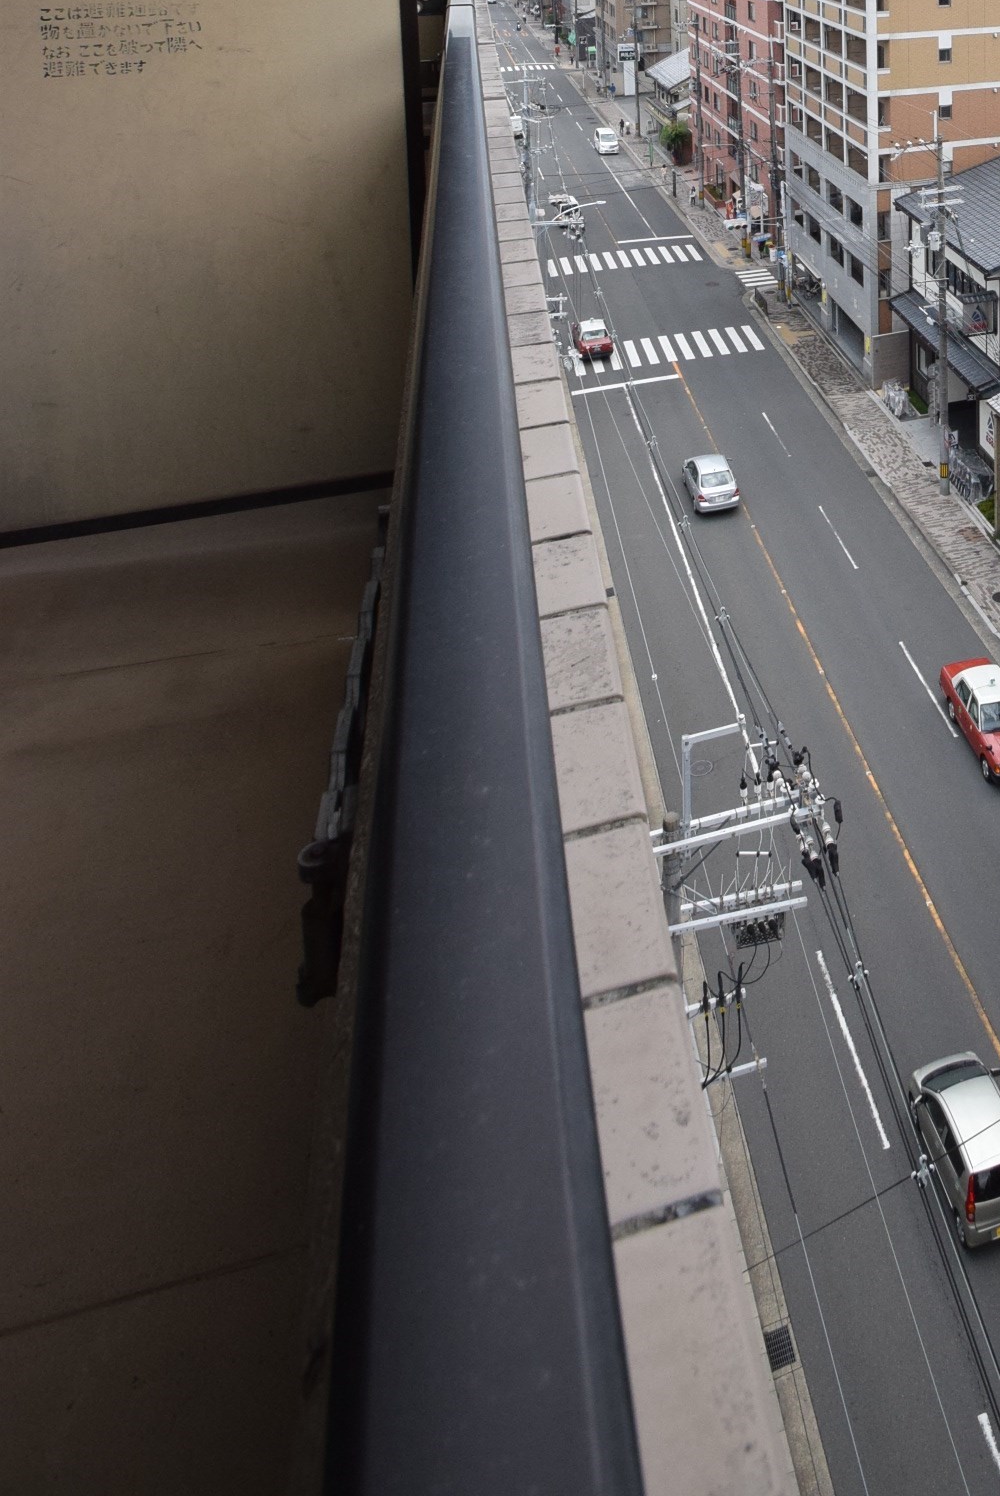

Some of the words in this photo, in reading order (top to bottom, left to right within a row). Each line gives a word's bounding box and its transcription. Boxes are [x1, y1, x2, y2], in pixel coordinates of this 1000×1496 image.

[42, 46, 70, 59] なお
[43, 60, 146, 78] 避難できます
